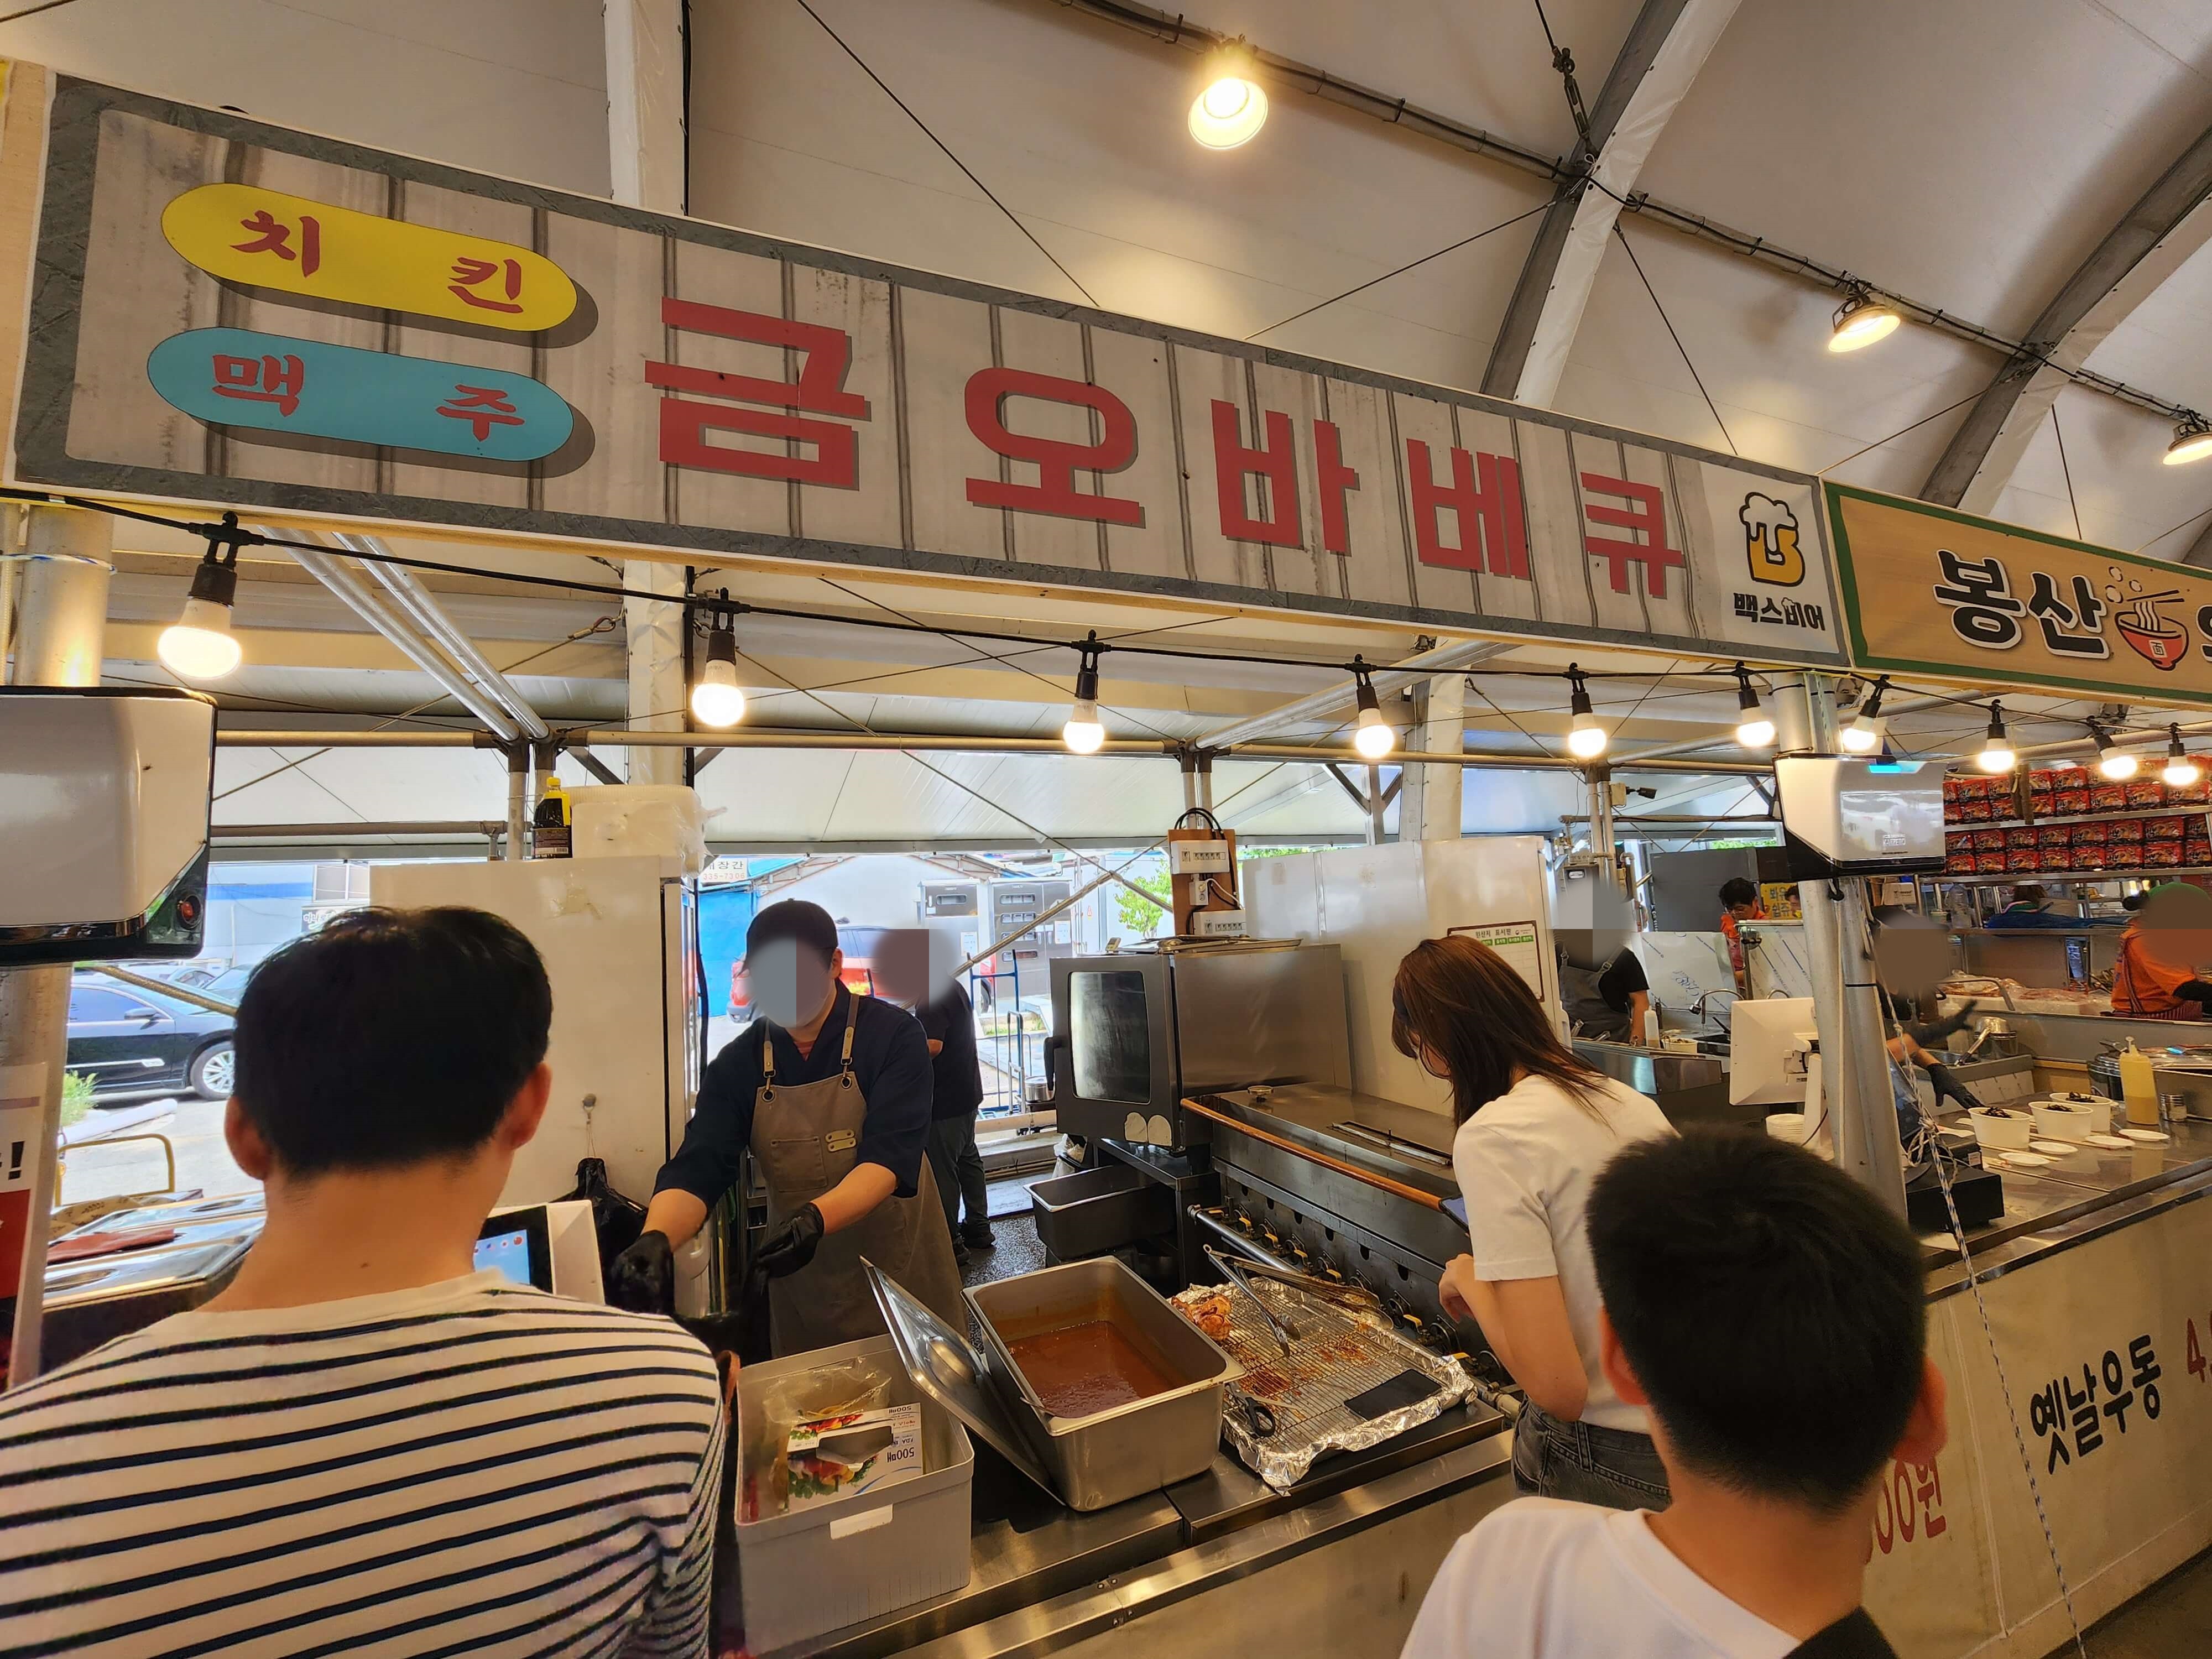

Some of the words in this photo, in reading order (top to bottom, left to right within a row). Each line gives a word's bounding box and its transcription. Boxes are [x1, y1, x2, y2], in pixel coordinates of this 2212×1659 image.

[229, 209, 524, 314] 치킨
[211, 353, 525, 442] 맥주
[645, 296, 1686, 598] 금오바베큐
[1733, 592, 1826, 632] 백스비어
[1934, 549, 2109, 659] 봉산
[2030, 1334, 2161, 1475] 옛날우동
[2187, 1311, 2212, 1383] 4
[886, 1446, 915, 1463] 500매
